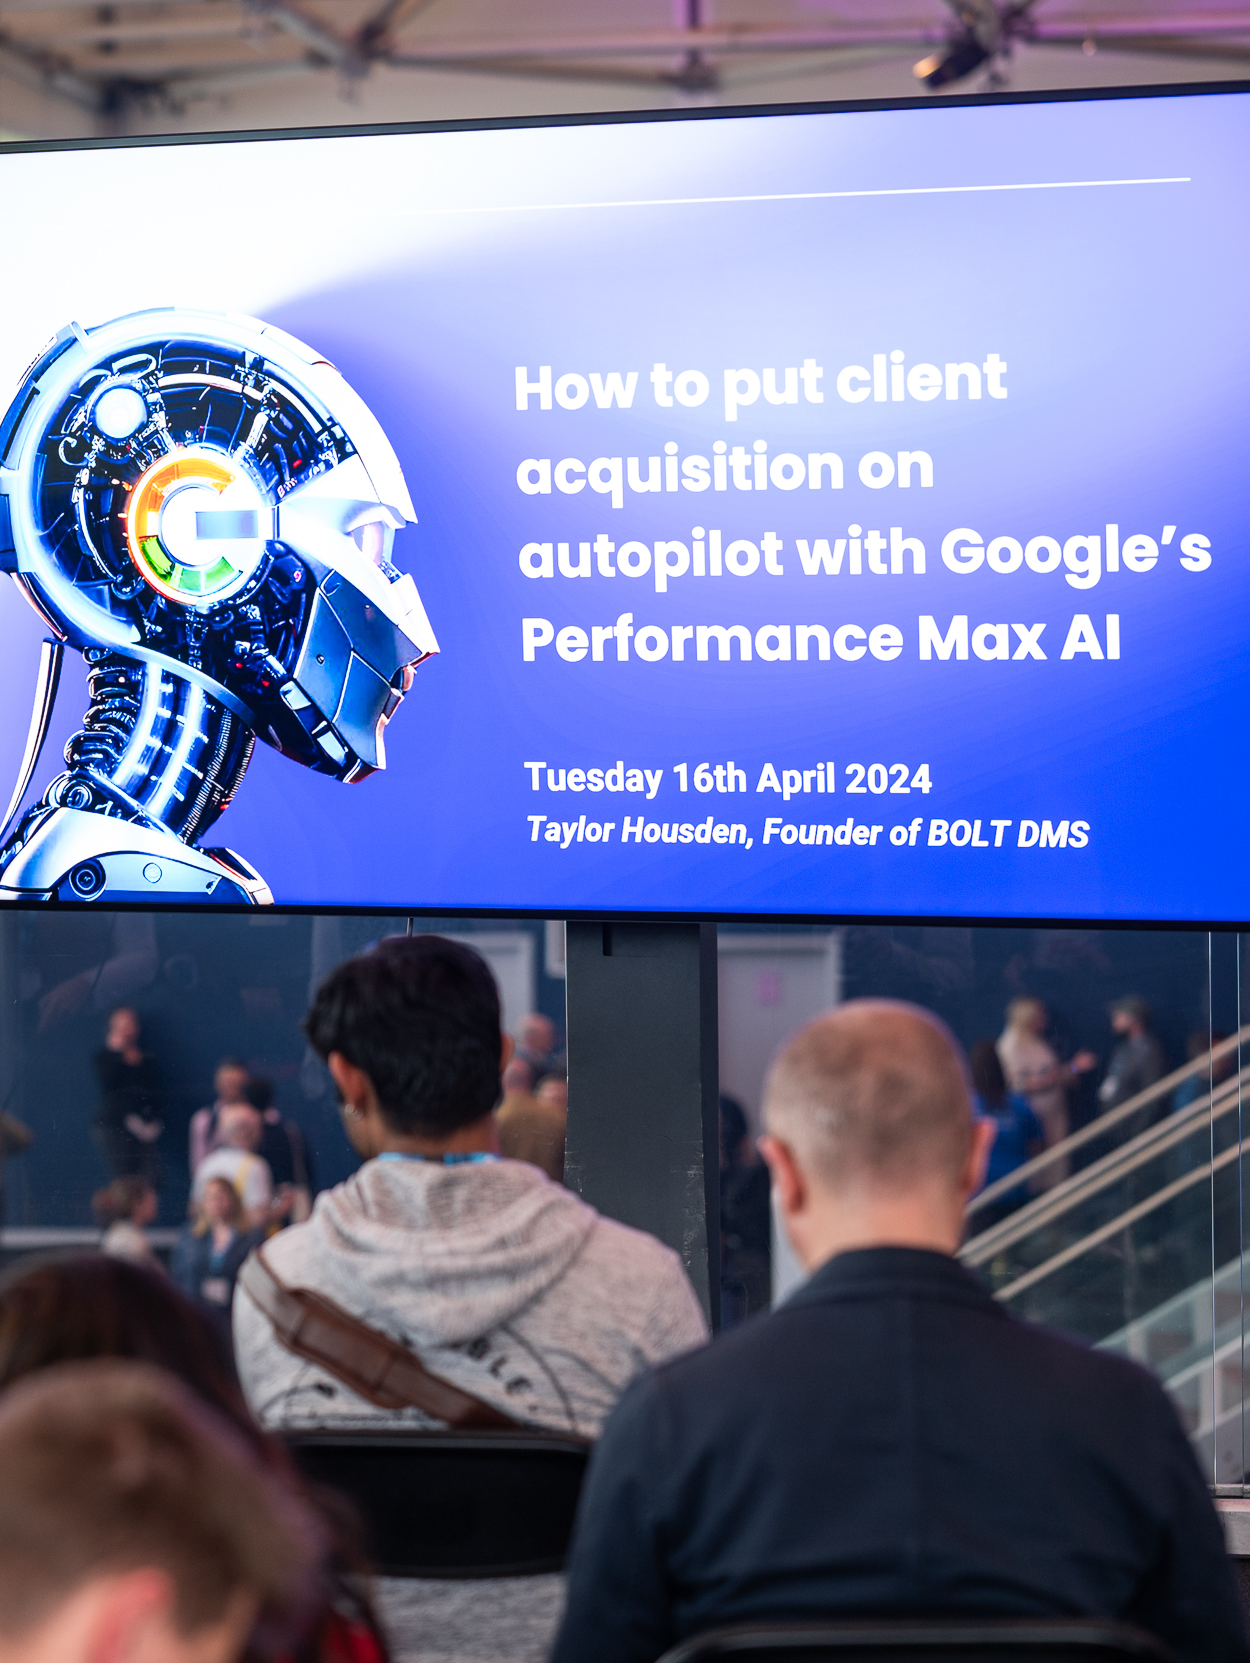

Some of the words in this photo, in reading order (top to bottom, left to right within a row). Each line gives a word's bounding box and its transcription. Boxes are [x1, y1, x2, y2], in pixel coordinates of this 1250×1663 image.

[514, 365, 640, 411] How
[649, 362, 710, 408] to
[723, 358, 824, 422] put
[836, 349, 1008, 404] client
[516, 438, 844, 509] acquisition
[857, 450, 934, 490] on
[518, 525, 784, 593] autopilot
[795, 523, 927, 576] with
[940, 523, 1213, 590] Google’s
[521, 612, 904, 663] Performance
[918, 614, 1048, 661] Max
[1059, 613, 1121, 660] AI
[523, 760, 664, 800] Tuesday
[673, 760, 747, 793] 16th
[755, 761, 836, 801] April
[844, 762, 933, 795] 2024
[526, 814, 615, 850] Taylor
[620, 815, 754, 850] Housden,
[762, 817, 884, 846] Founder
[889, 817, 923, 847] of
[927, 818, 1013, 848] BOLT
[1017, 819, 1091, 849] DMS
